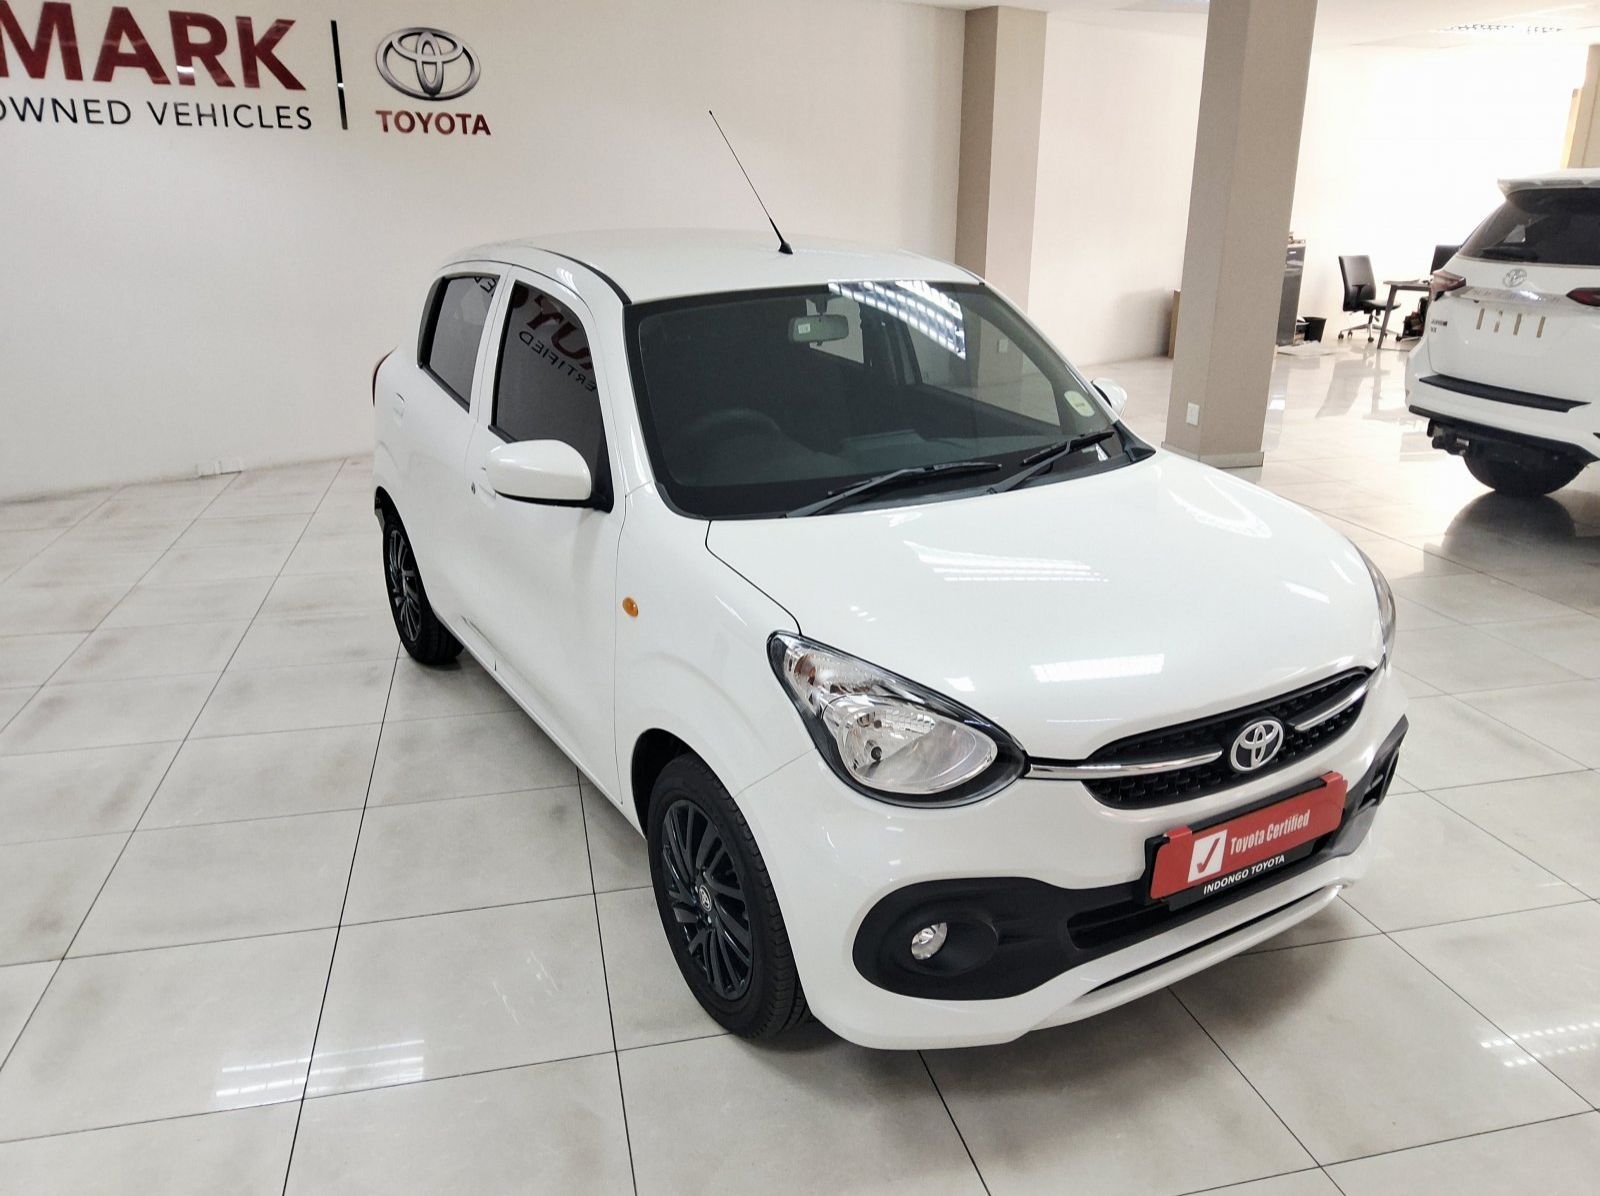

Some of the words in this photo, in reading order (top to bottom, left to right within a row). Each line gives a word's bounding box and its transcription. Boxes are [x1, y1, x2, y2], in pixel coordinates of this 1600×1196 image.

[0, 0, 306, 91] MARK
[0, 96, 131, 125] WNED
[146, 101, 312, 130] VEHICLES
[375, 110, 491, 135] TOYOTA
[1230, 829, 1265, 856] Toyota
[1266, 809, 1310, 842] Certified
[1203, 869, 1249, 896] INDONGO
[1251, 854, 1285, 876] TOYOTA
